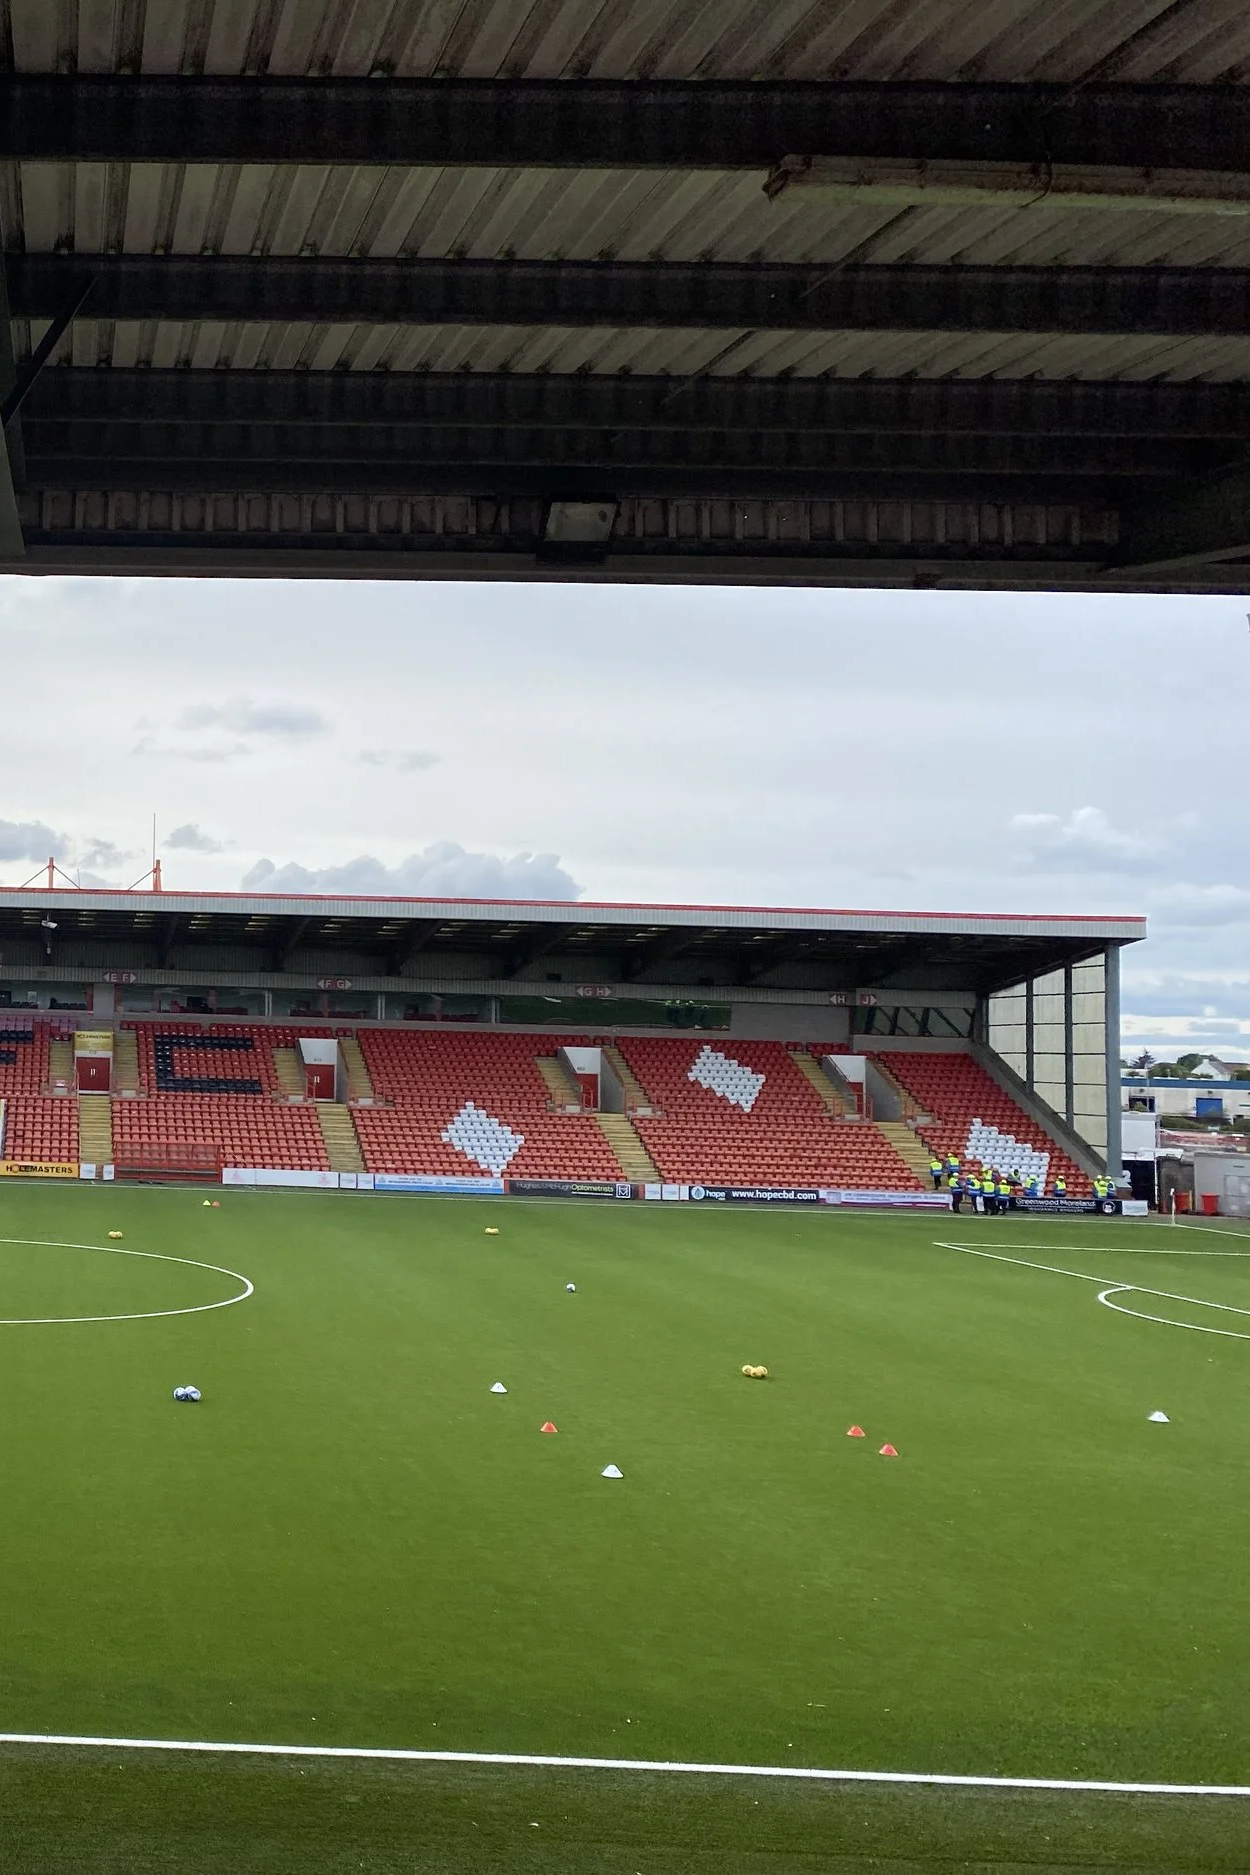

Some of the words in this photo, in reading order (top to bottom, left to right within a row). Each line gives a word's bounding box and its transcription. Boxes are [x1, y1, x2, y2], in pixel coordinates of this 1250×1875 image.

[153, 1034, 263, 1095] C
[5, 1163, 74, 1174] HOLEMASTERS
[571, 1183, 614, 1193] Optometrists
[706, 1190, 726, 1199] hope
[732, 1189, 817, 1201] www.hopecbd.com
[1015, 1198, 1059, 1206] Greenwood
[1060, 1199, 1097, 1207] Moreland
